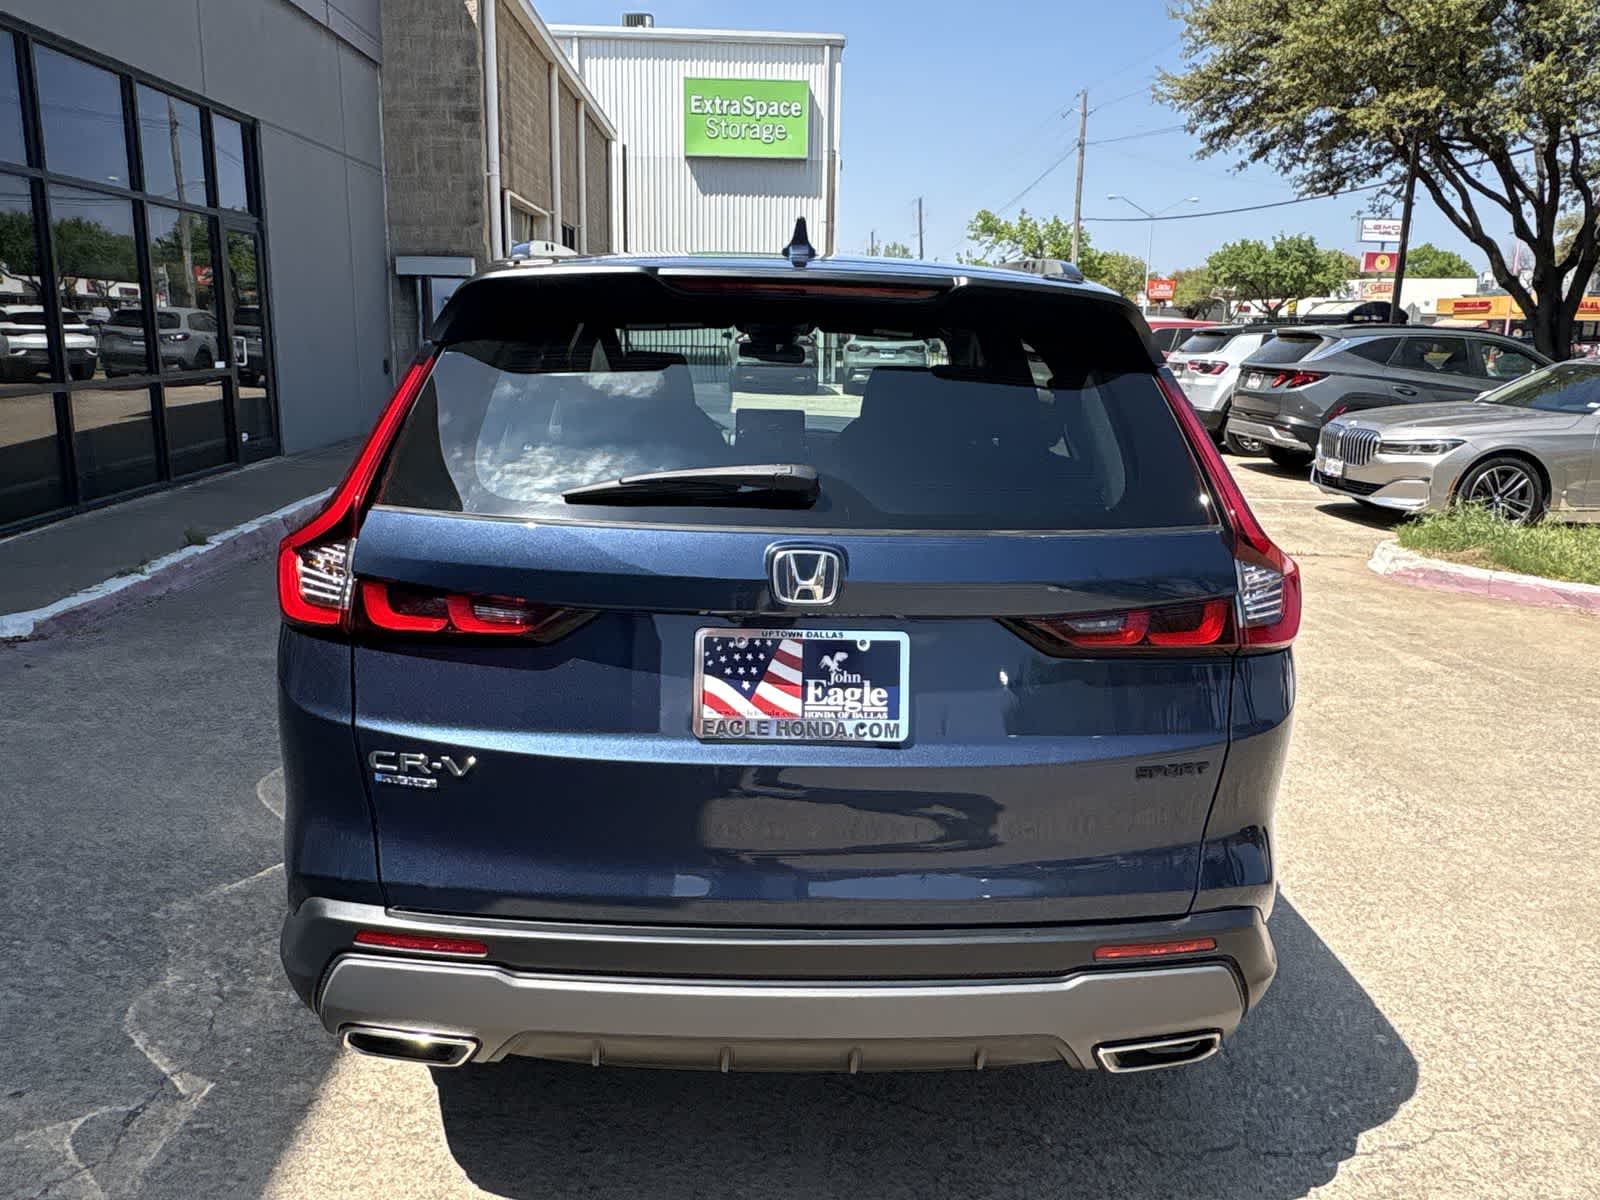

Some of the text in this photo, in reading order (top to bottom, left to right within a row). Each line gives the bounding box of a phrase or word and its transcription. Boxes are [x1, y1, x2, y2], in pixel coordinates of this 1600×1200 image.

[705, 117, 787, 143] Storage
[761, 630, 804, 638] UPTOWN
[827, 671, 862, 686] John
[804, 679, 889, 713] Eagle
[804, 711, 836, 720] HONDA
[837, 711, 850, 720] OF
[851, 711, 889, 720] DALLAS
[702, 720, 901, 739] EAGLE HONDA.COM
[368, 750, 477, 777] CR-V
